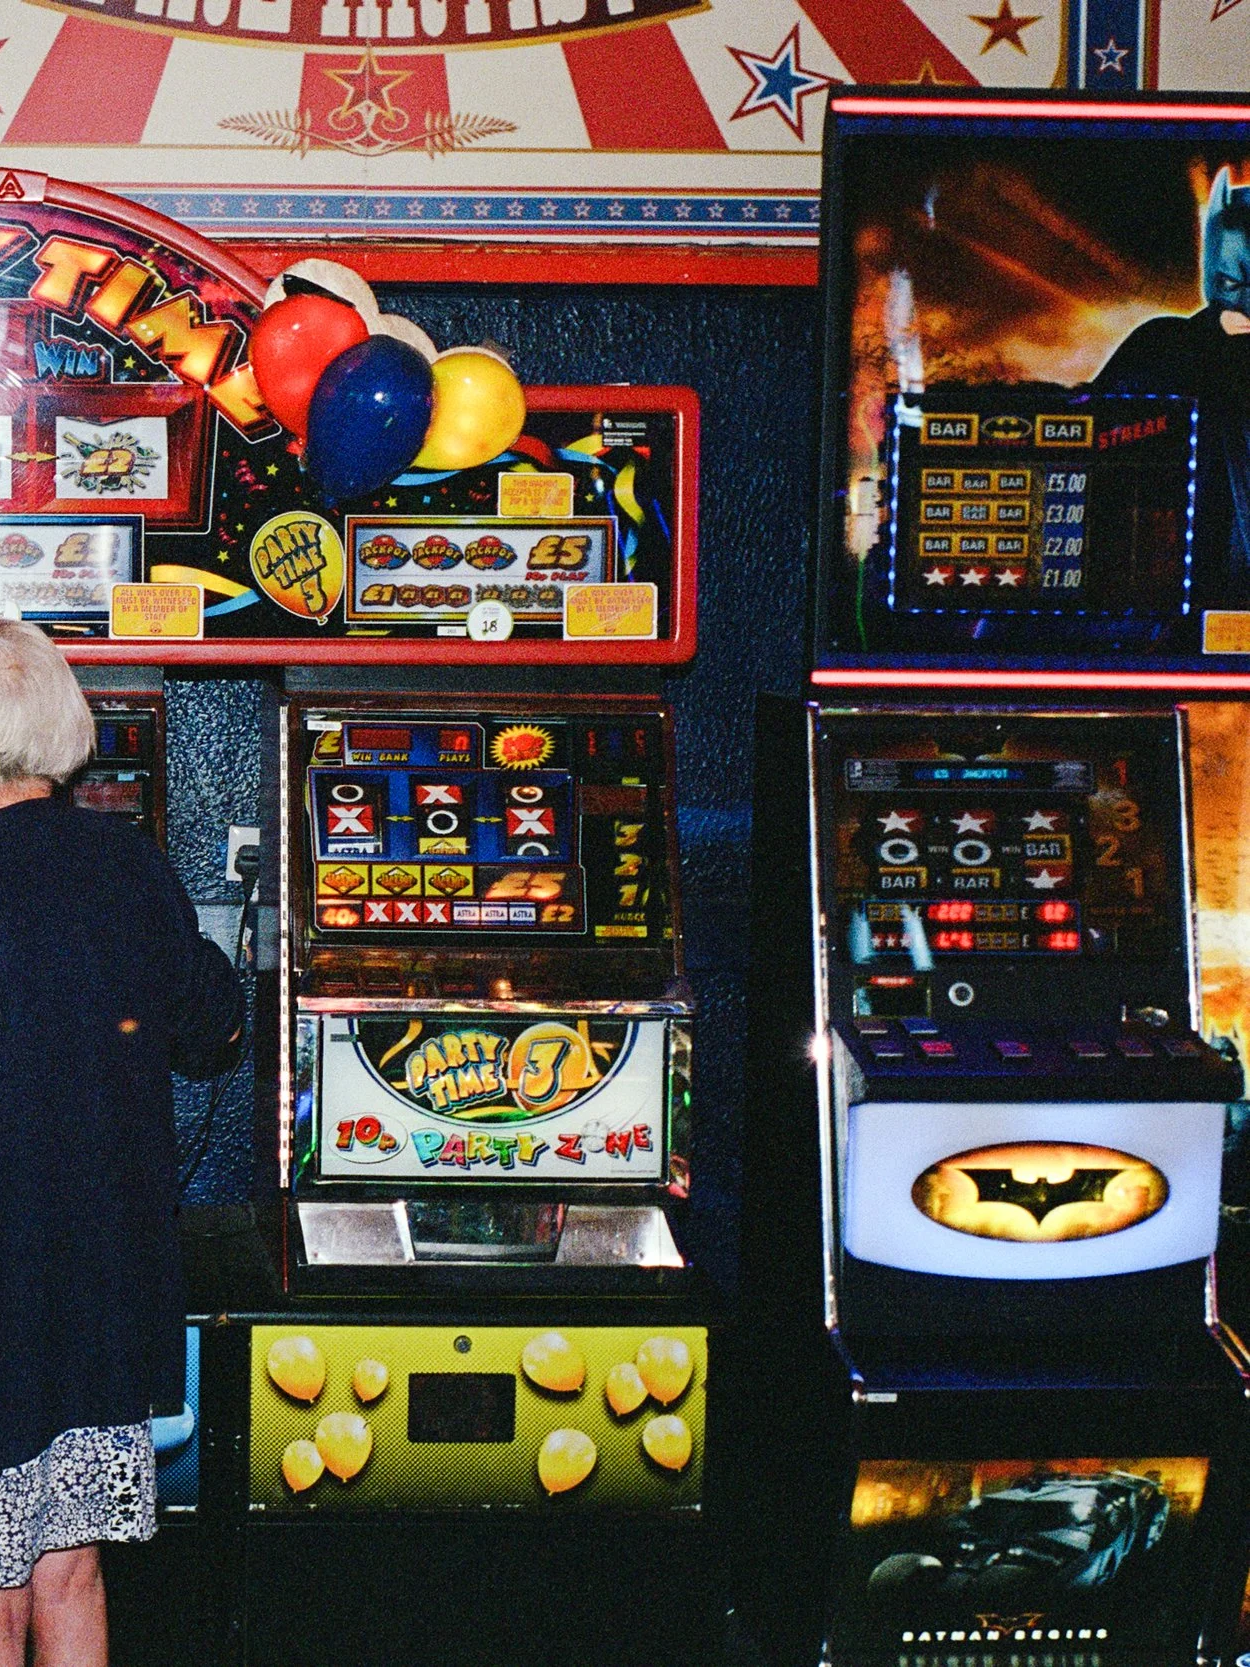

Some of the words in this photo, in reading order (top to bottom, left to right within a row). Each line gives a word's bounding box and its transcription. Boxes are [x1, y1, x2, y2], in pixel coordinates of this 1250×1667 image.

[35, 341, 100, 378] WIN
[930, 422, 967, 437] BAR
[1045, 424, 1082, 438] BAR
[1098, 415, 1167, 451] STREAK
[80, 449, 135, 477] £2
[927, 476, 950, 487] BAR
[1000, 477, 1024, 488] BAR
[1047, 473, 1086, 494] £5.00
[926, 507, 950, 518] BAR
[999, 507, 1022, 519] BAR
[1046, 504, 1084, 524] £3.00
[255, 521, 322, 579] PARTY
[361, 544, 410, 561] JACKPOT
[412, 544, 462, 561] JACKPOT
[465, 544, 514, 561] JACKPOT
[527, 535, 591, 571] £5
[925, 540, 949, 551] BAR
[961, 540, 986, 551] BAR
[997, 540, 1022, 551] BAR
[1043, 537, 1082, 556] £2.00
[274, 546, 327, 590] TIME
[551, 571, 589, 582] PLAY
[1043, 569, 1081, 588] £1.00
[116, 597, 137, 605] MUST
[140, 597, 150, 605] BE
[153, 597, 197, 605] WITNESSED
[121, 589, 134, 597] ALL
[136, 589, 157, 597] WINS
[159, 589, 180, 597] OVER
[301, 574, 328, 614] 3
[361, 584, 397, 606] £1
[122, 605, 131, 613] BY
[141, 605, 178, 613] MEMBER
[178, 605, 188, 613] OF
[144, 613, 167, 621] STAFF
[483, 620, 499, 633] 18
[352, 752, 371, 762] WIN
[379, 752, 409, 762] BANK
[439, 752, 471, 763] PLAYS
[962, 769, 1009, 779] JACKPOT
[1113, 800, 1141, 832] 3
[1025, 842, 1061, 857] BAR
[1096, 836, 1121, 867] 2
[614, 853, 642, 876] 2
[485, 871, 568, 900] £5
[881, 875, 917, 889] BAR
[954, 877, 991, 889] BAR
[322, 907, 360, 926] 40p
[456, 909, 478, 918] ASTRA
[484, 909, 505, 919] ASTRA
[512, 910, 534, 920] ASTRA
[541, 904, 575, 923] £2
[407, 1030, 508, 1097] PARTY
[519, 1038, 569, 1103] 3
[428, 1062, 507, 1113] TIME
[337, 1115, 401, 1153] 10p
[411, 1127, 550, 1170] PARTY
[902, 1630, 1001, 1643] BATMAN
[1014, 1626, 1108, 1642] BEGINS
